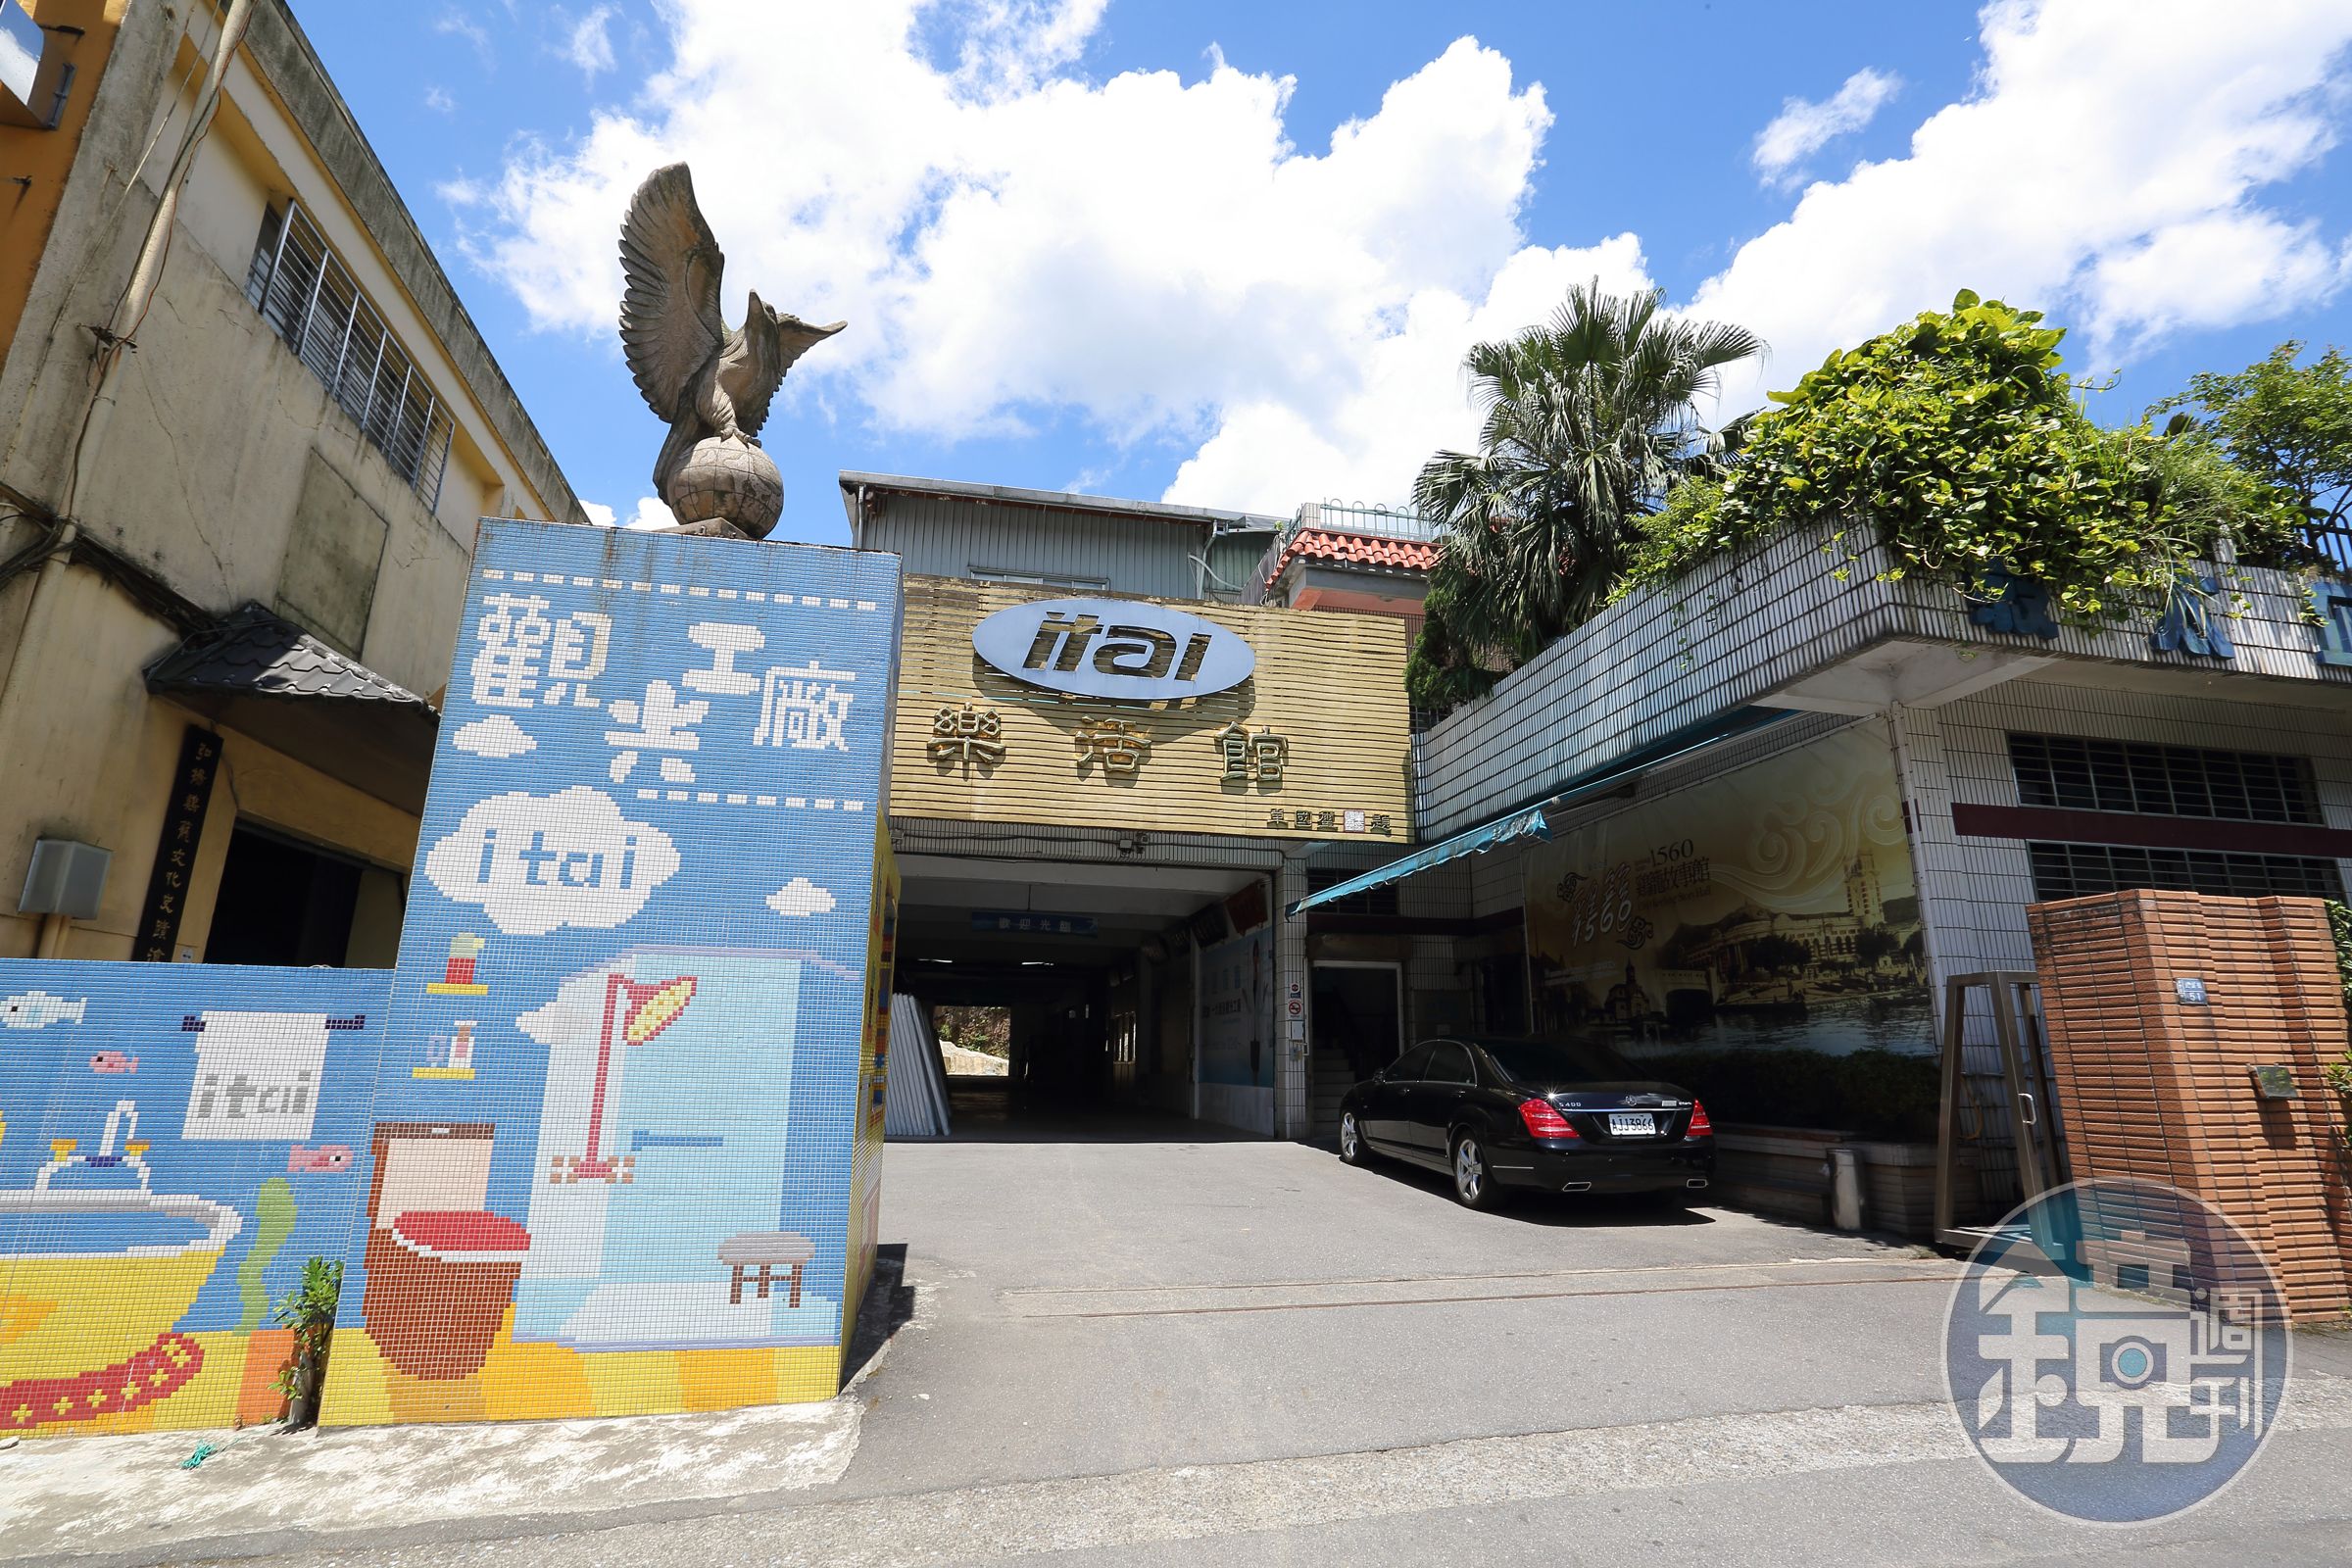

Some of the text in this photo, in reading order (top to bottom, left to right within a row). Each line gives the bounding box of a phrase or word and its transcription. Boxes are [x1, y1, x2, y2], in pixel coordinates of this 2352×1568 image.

[470, 592, 860, 785] 觀光工廠
[926, 702, 1289, 782] 樂活館
[477, 827, 637, 890] itai
[1649, 838, 1694, 867] 1560
[998, 916, 1072, 934] 歡迎光臨
[2188, 992, 2202, 1002] 51
[196, 1069, 313, 1120] itai
